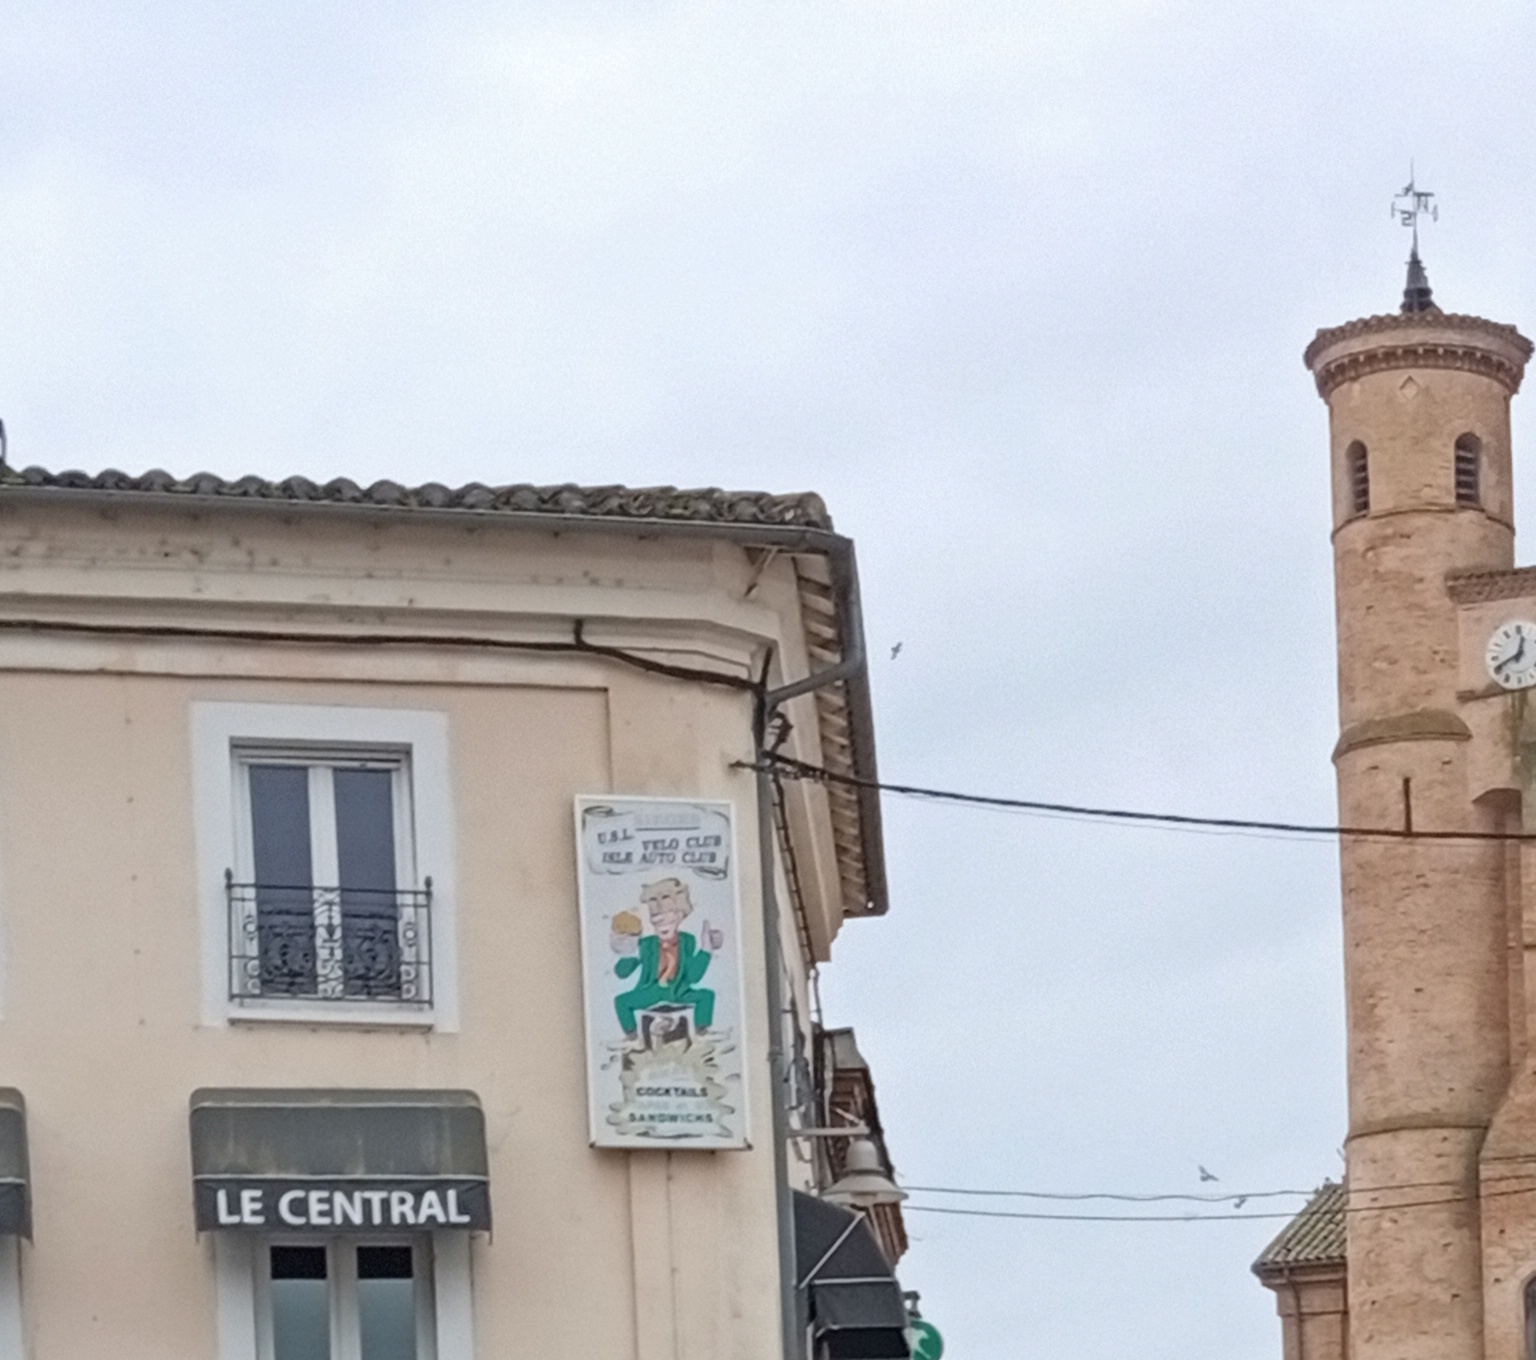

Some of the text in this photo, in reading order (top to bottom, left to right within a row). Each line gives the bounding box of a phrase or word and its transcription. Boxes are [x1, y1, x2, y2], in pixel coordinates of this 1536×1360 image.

[686, 834, 722, 849] CLUB
[639, 851, 676, 864] AUTO
[682, 851, 717, 864] CLUB
[636, 1086, 708, 1097] COCKTAILS
[216, 1188, 471, 1226] LE CENTRAL
